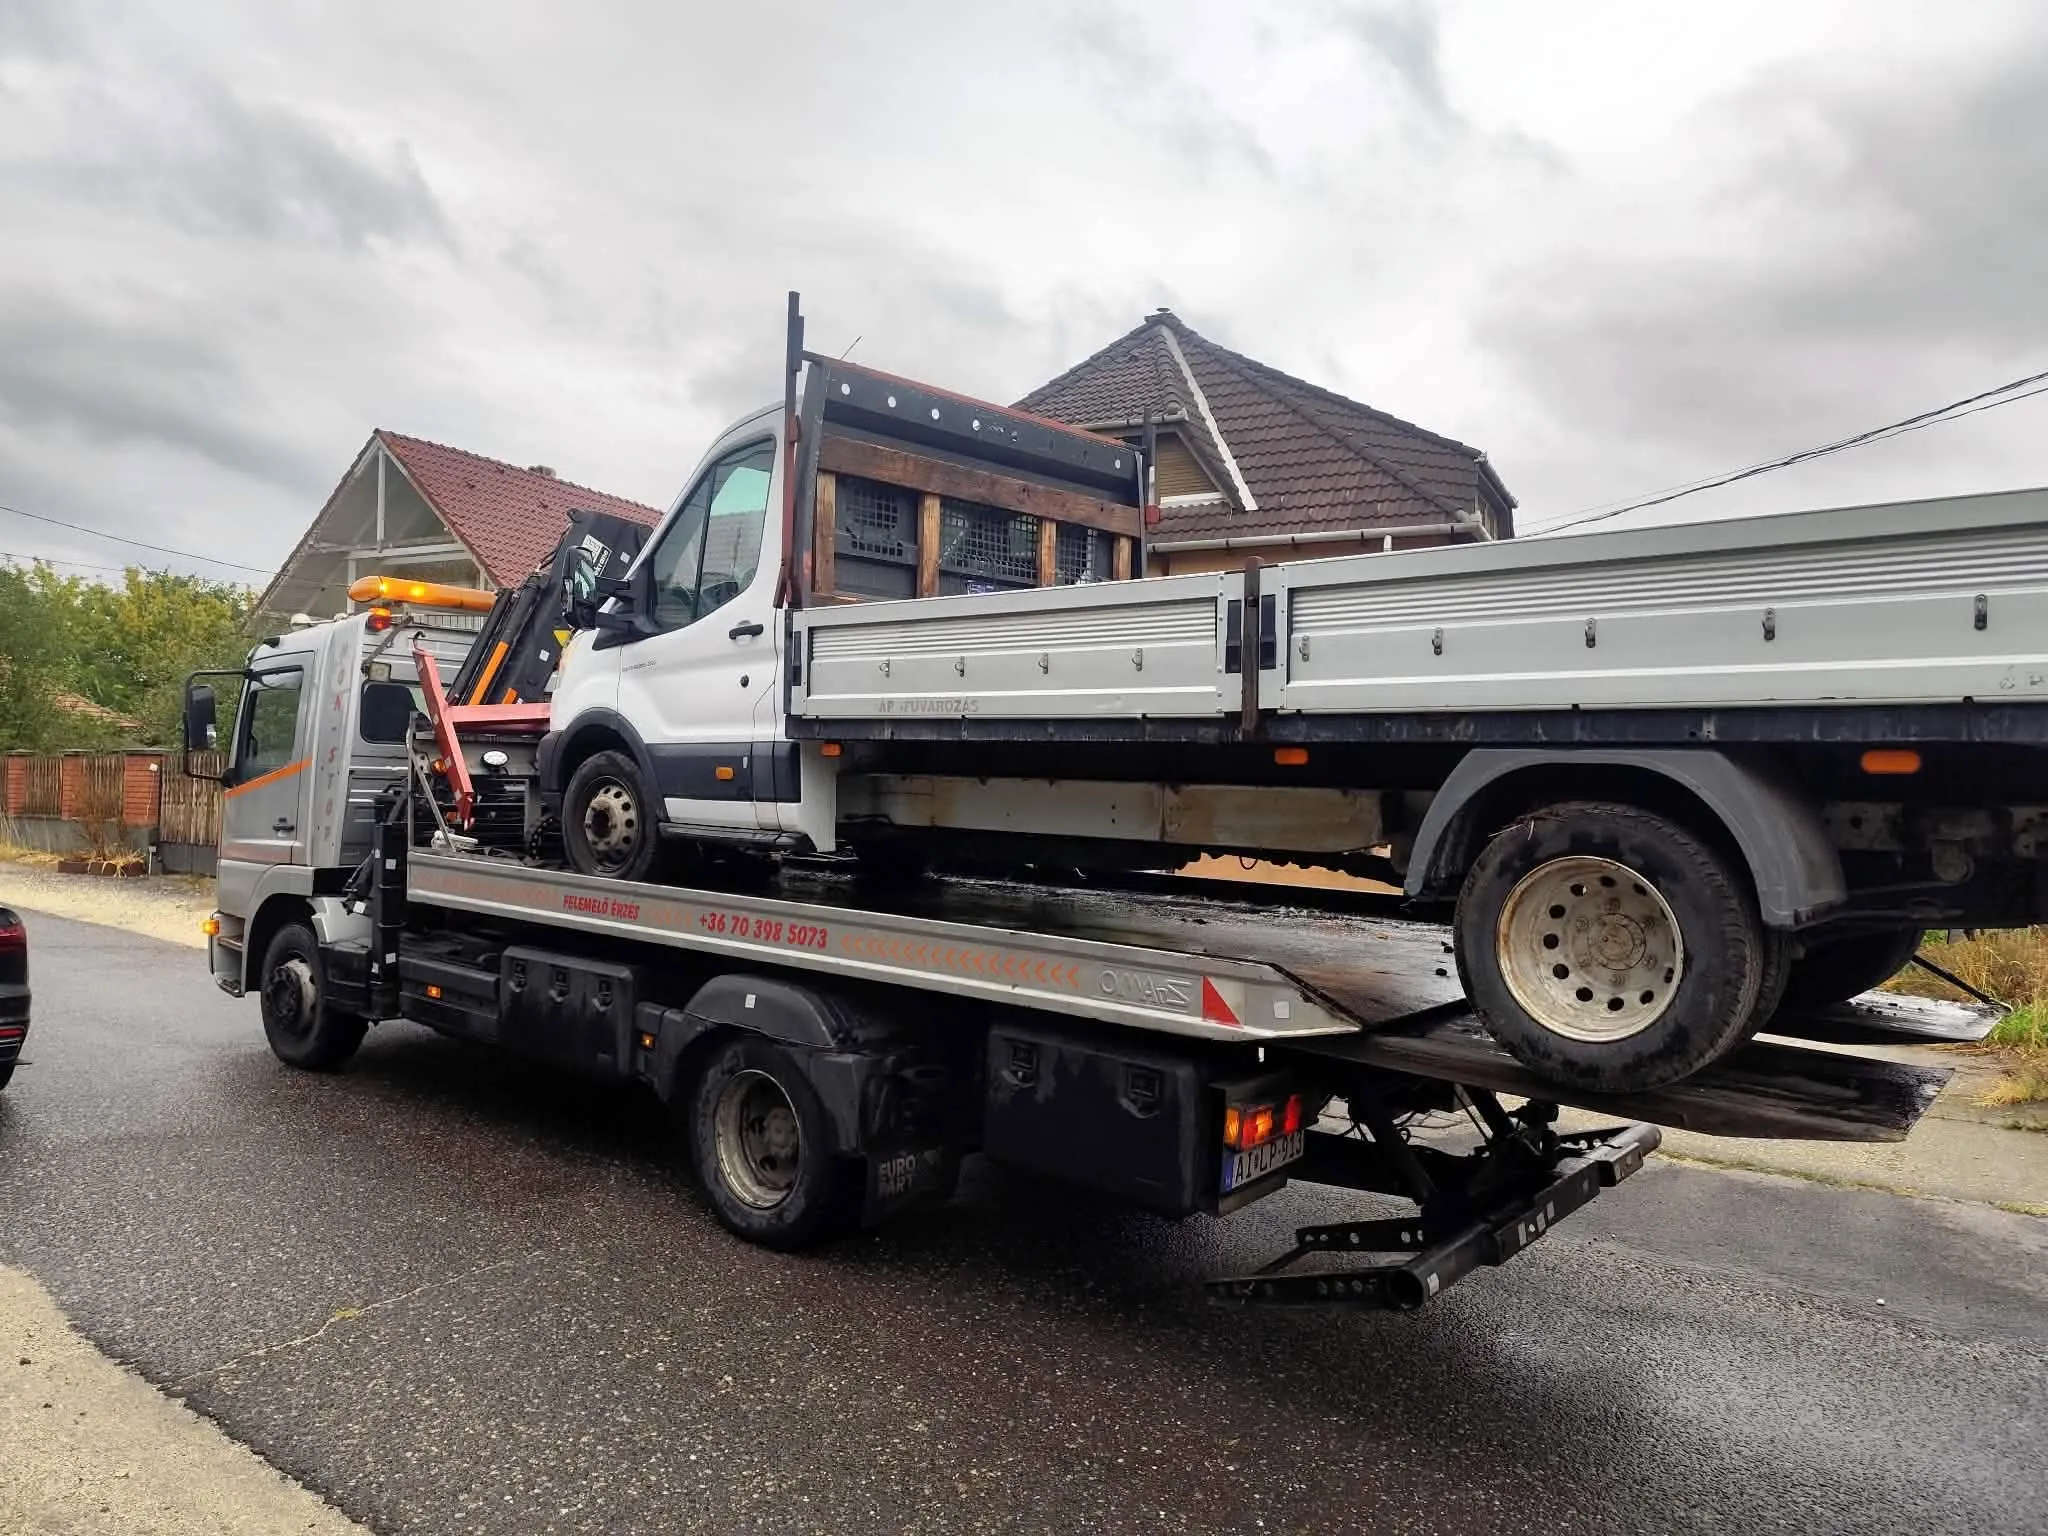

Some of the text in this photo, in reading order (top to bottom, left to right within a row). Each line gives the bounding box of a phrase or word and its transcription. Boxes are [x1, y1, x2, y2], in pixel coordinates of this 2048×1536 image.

[700, 911, 828, 949] +36 70 398 5073
[878, 1155, 916, 1178] EURO
